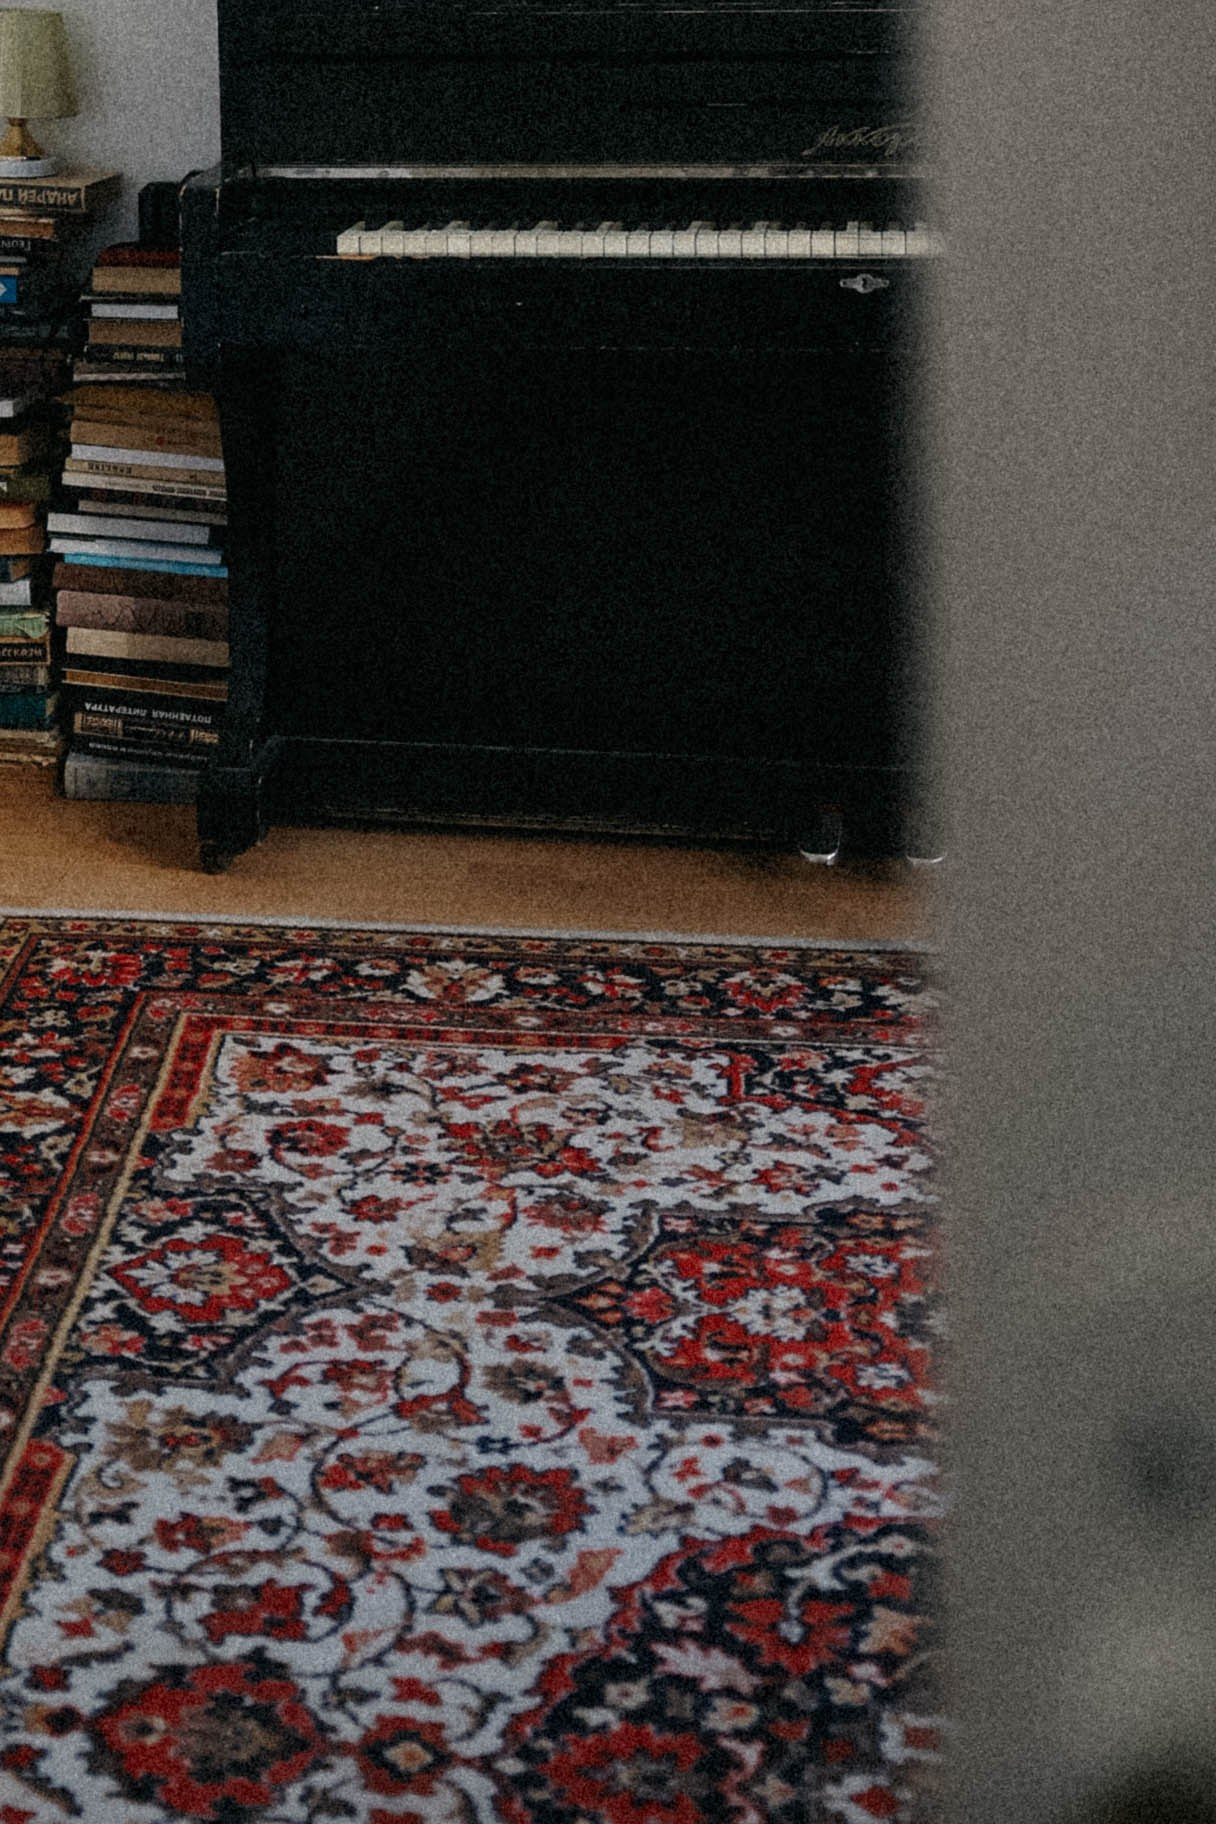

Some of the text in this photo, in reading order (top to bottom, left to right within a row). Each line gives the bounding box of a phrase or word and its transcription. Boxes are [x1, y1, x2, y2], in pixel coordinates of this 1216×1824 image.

[18, 191, 78, 205] АНДРЕЙ
[84, 702, 212, 724] ПОТАЕННАЯ ЛИТЕРАТУРА
